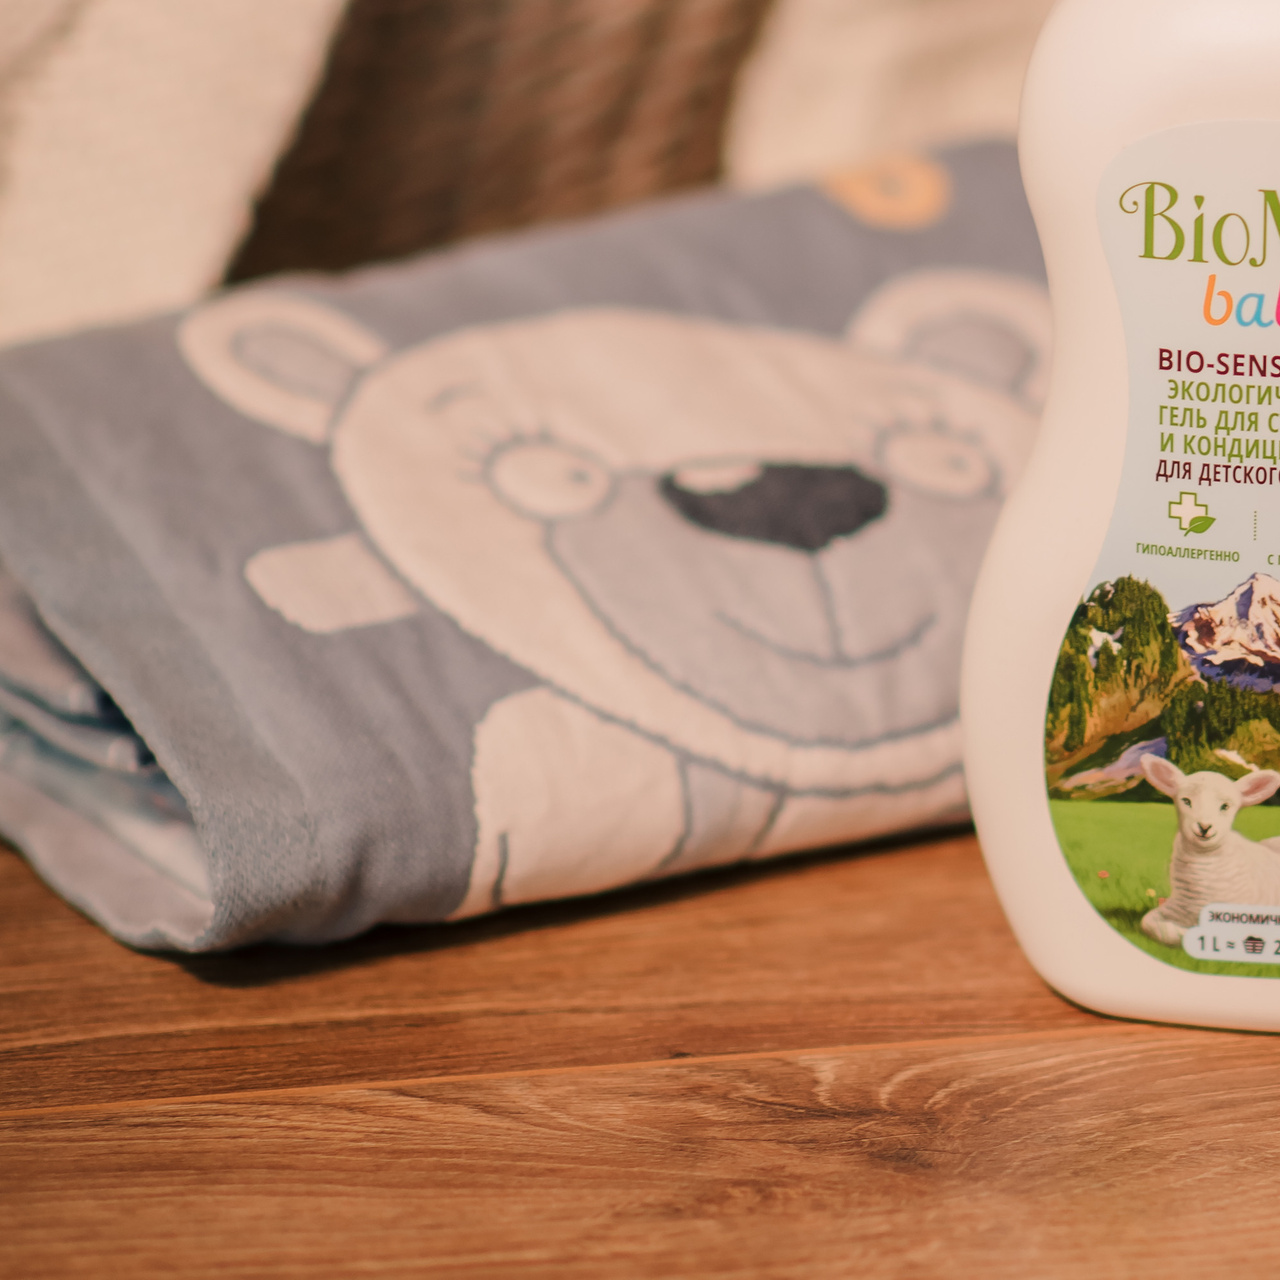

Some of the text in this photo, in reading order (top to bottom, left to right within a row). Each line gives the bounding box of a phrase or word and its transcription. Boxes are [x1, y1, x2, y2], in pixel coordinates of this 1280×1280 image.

[1158, 405, 1208, 429] ГЕЛЬ
[1214, 409, 1259, 435] ДЛЯ
[1159, 432, 1175, 454] И
[1155, 459, 1192, 482] ДЛЯ
[1135, 542, 1241, 563] ГИПОАЛЛЕРГЕННО
[1266, 554, 1275, 566] С
[1198, 936, 1205, 951] 1
[1213, 937, 1220, 952] L
